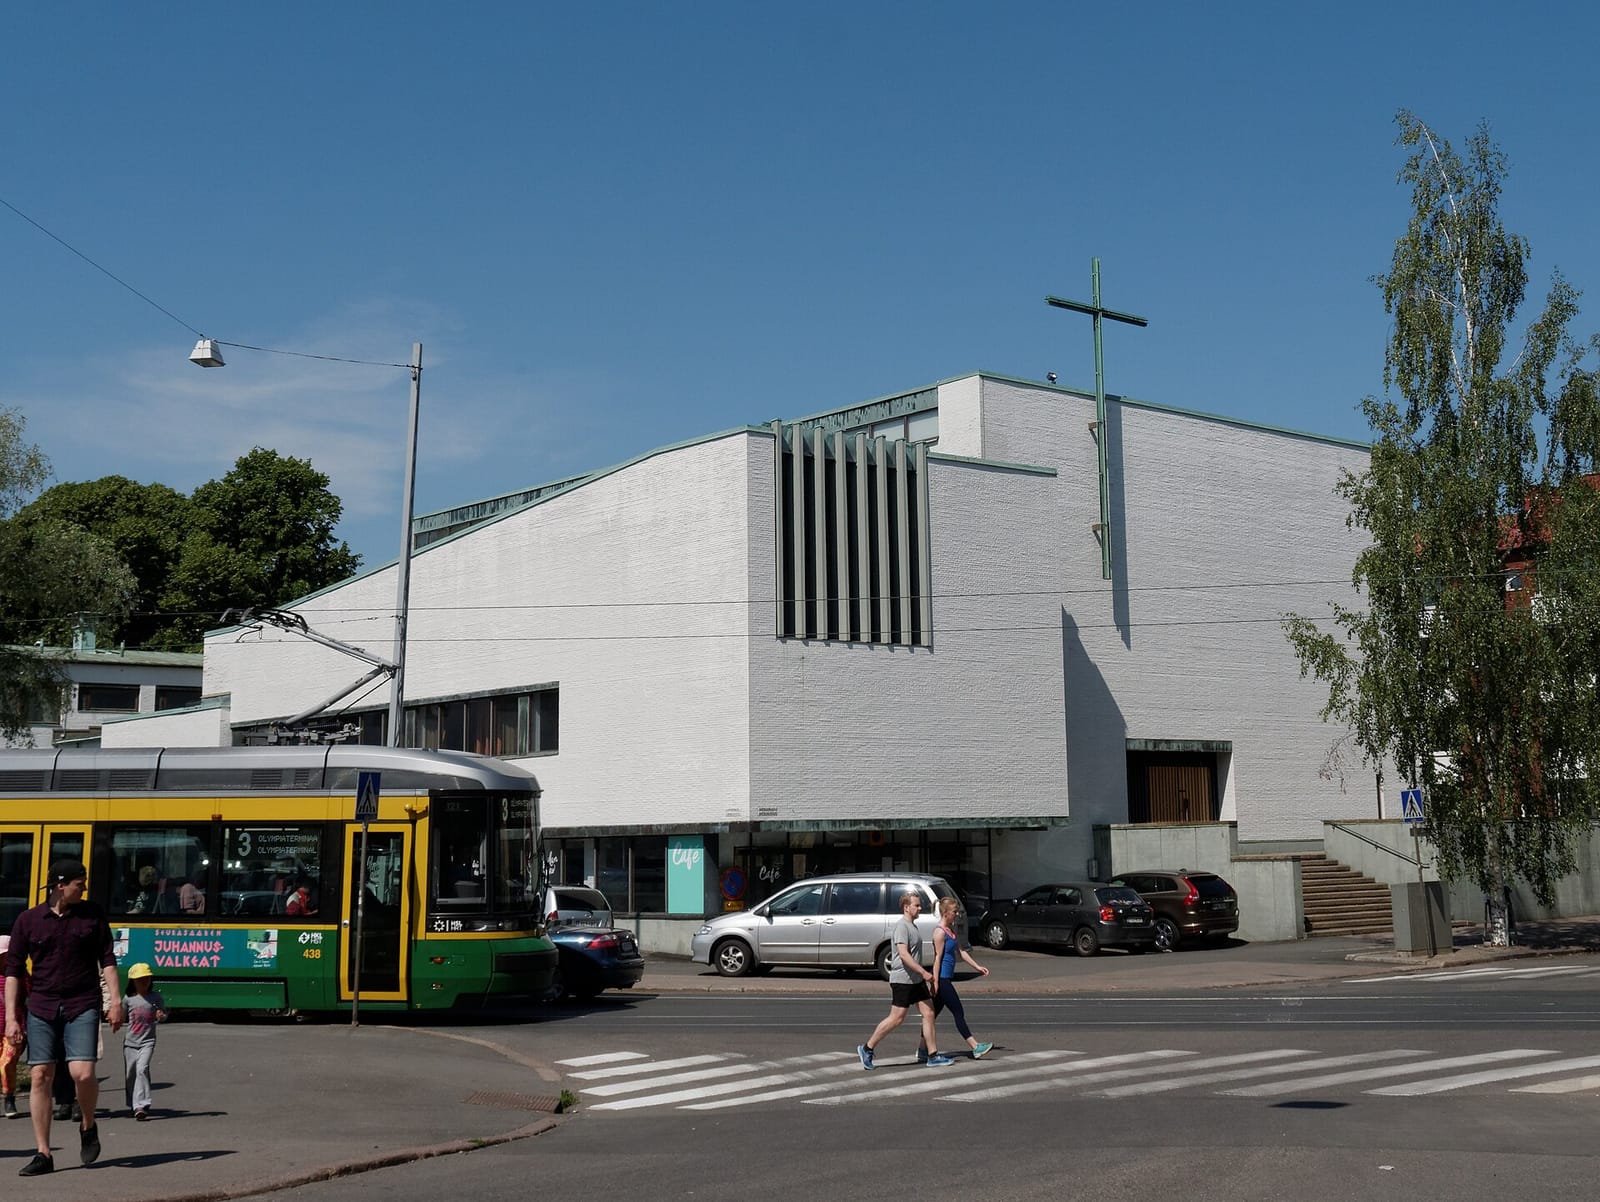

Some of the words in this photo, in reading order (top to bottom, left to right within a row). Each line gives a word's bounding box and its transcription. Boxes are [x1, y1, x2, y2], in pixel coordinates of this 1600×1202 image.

[502, 798, 509, 822] 3
[237, 832, 252, 857] 3
[672, 841, 701, 871] Café
[759, 865, 781, 884] Café
[154, 940, 225, 953] JUHANNUS-
[303, 948, 321, 959] 438
[154, 954, 220, 968] VALKEAT
